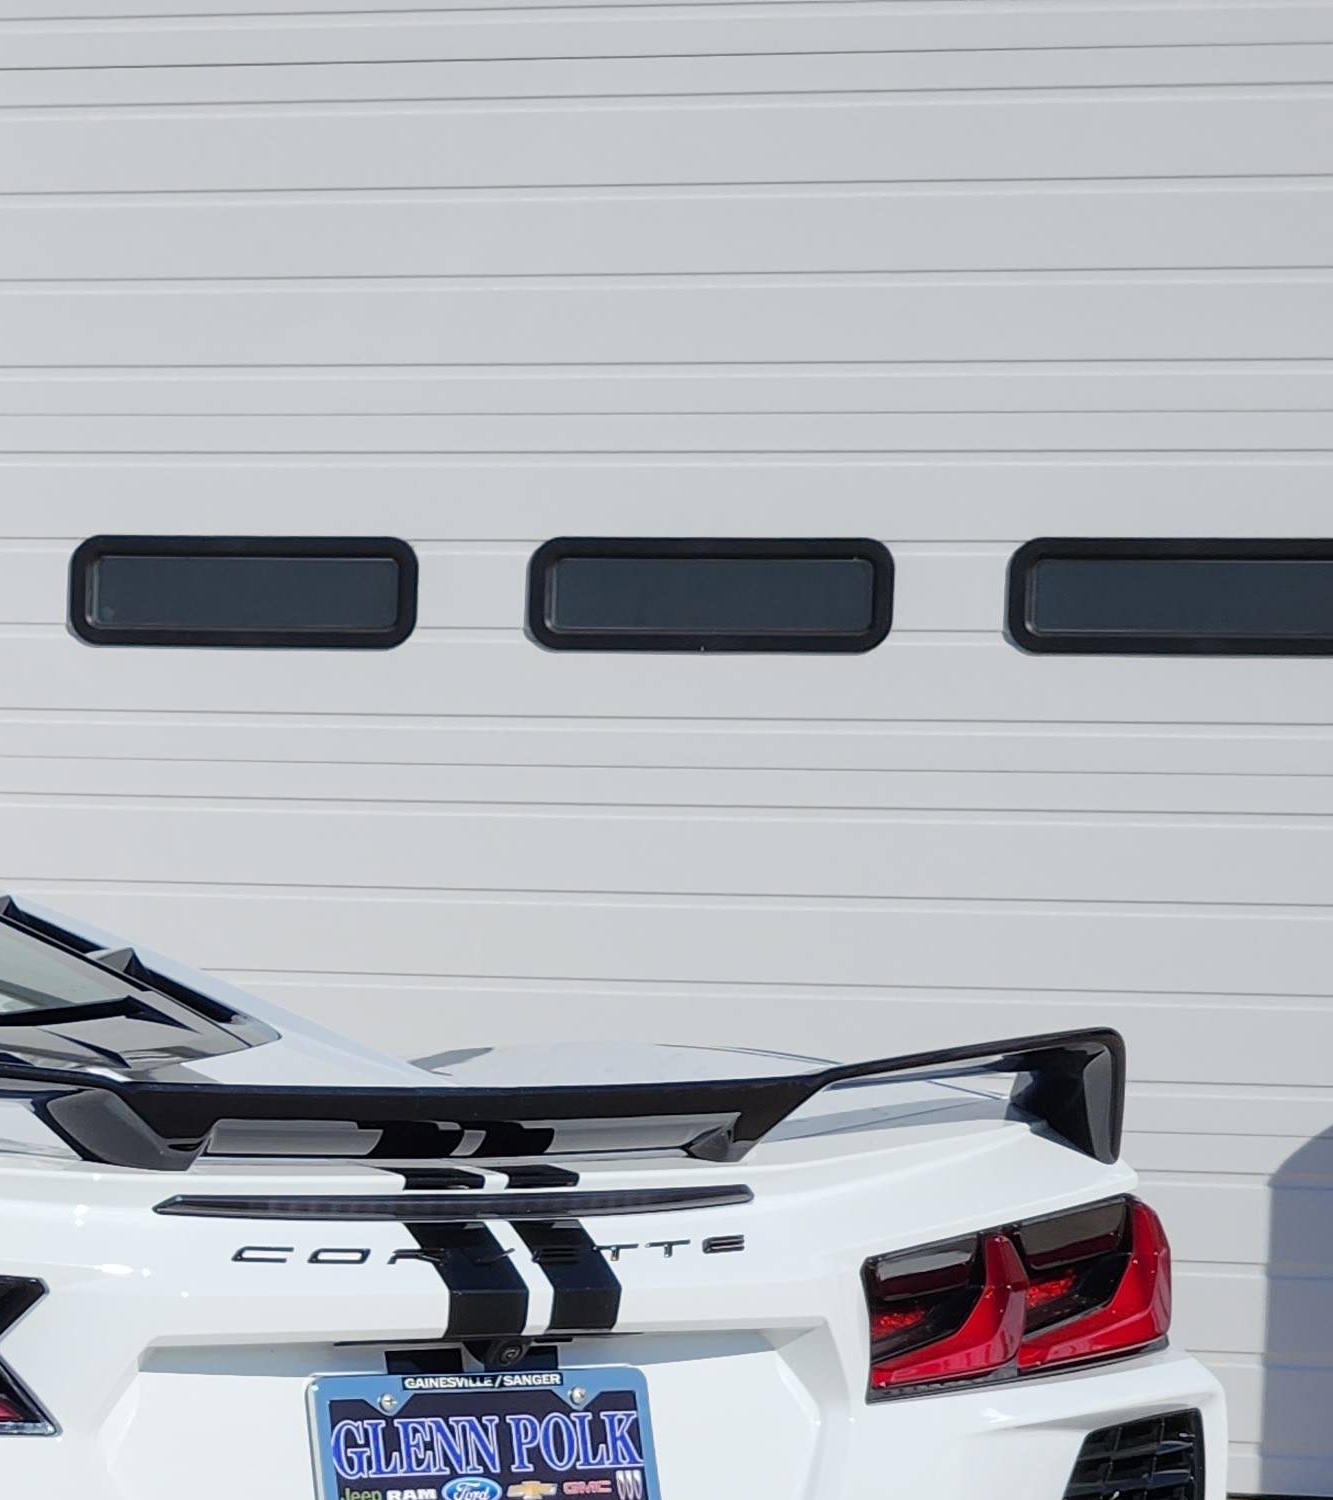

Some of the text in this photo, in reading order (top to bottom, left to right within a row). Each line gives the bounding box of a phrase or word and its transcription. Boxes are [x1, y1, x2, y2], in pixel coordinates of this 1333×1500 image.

[232, 1235, 745, 1265] CORVETTE
[332, 1411, 645, 1480] GLENN POLK
[562, 1480, 612, 1494] GMC
